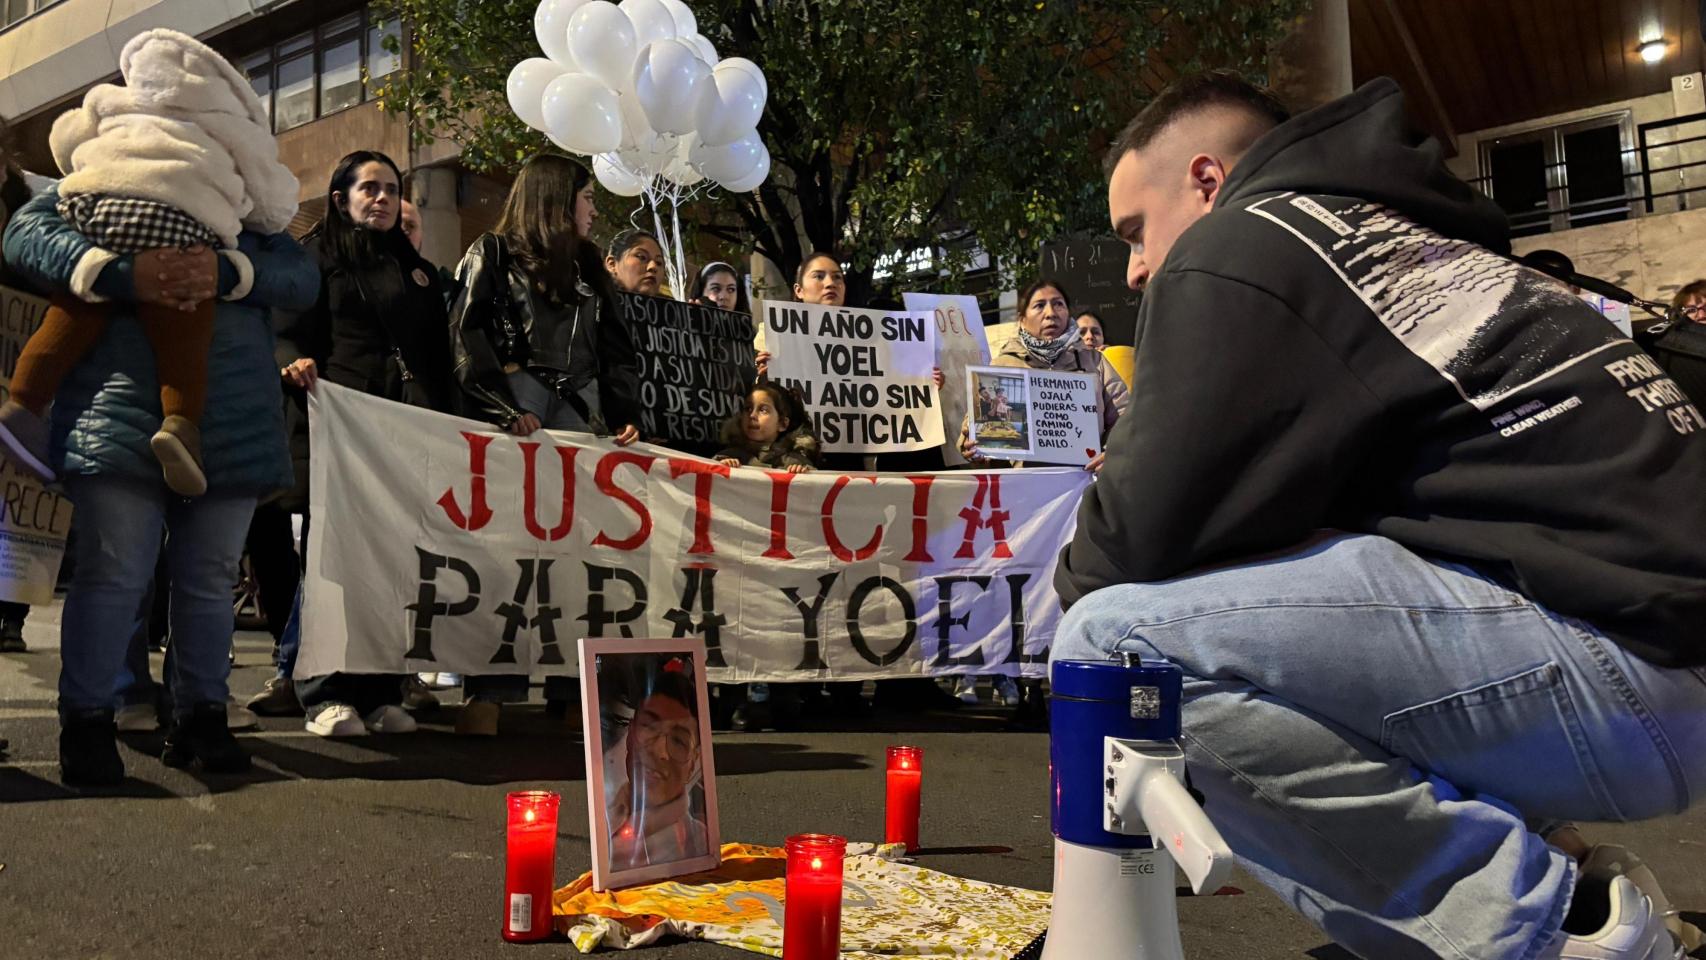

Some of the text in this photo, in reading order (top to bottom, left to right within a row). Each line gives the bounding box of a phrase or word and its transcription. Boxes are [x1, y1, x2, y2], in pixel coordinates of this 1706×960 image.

[1682, 77, 1693, 89] 2
[664, 301, 697, 333] QUE
[702, 307, 754, 341] DAMOS
[768, 306, 925, 342] UN AÑO SIN
[935, 305, 972, 335] OEL
[631, 323, 643, 352] A
[646, 325, 707, 360] JUSTICIA
[710, 336, 729, 363] ES
[813, 343, 884, 377] YOEL
[653, 356, 667, 381] A
[669, 356, 694, 386] SU
[700, 361, 745, 394] VIDA
[1030, 376, 1087, 391] HERMANITO
[662, 383, 696, 416] DE
[698, 388, 726, 417] SU
[820, 378, 880, 407] AÑO
[886, 384, 932, 409] SIN
[1032, 401, 1098, 414] PUDIERAS VER
[662, 411, 722, 443] RESUE
[812, 411, 924, 445] STICIA
[1043, 411, 1069, 421] COMO
[1500, 395, 1583, 438] CLEAR WEATHER
[1036, 429, 1067, 438] CORRO
[1038, 438, 1073, 449] BAILO.
[436, 431, 1014, 562] JUSTICIA
[404, 545, 1050, 670] PARA YOEL
